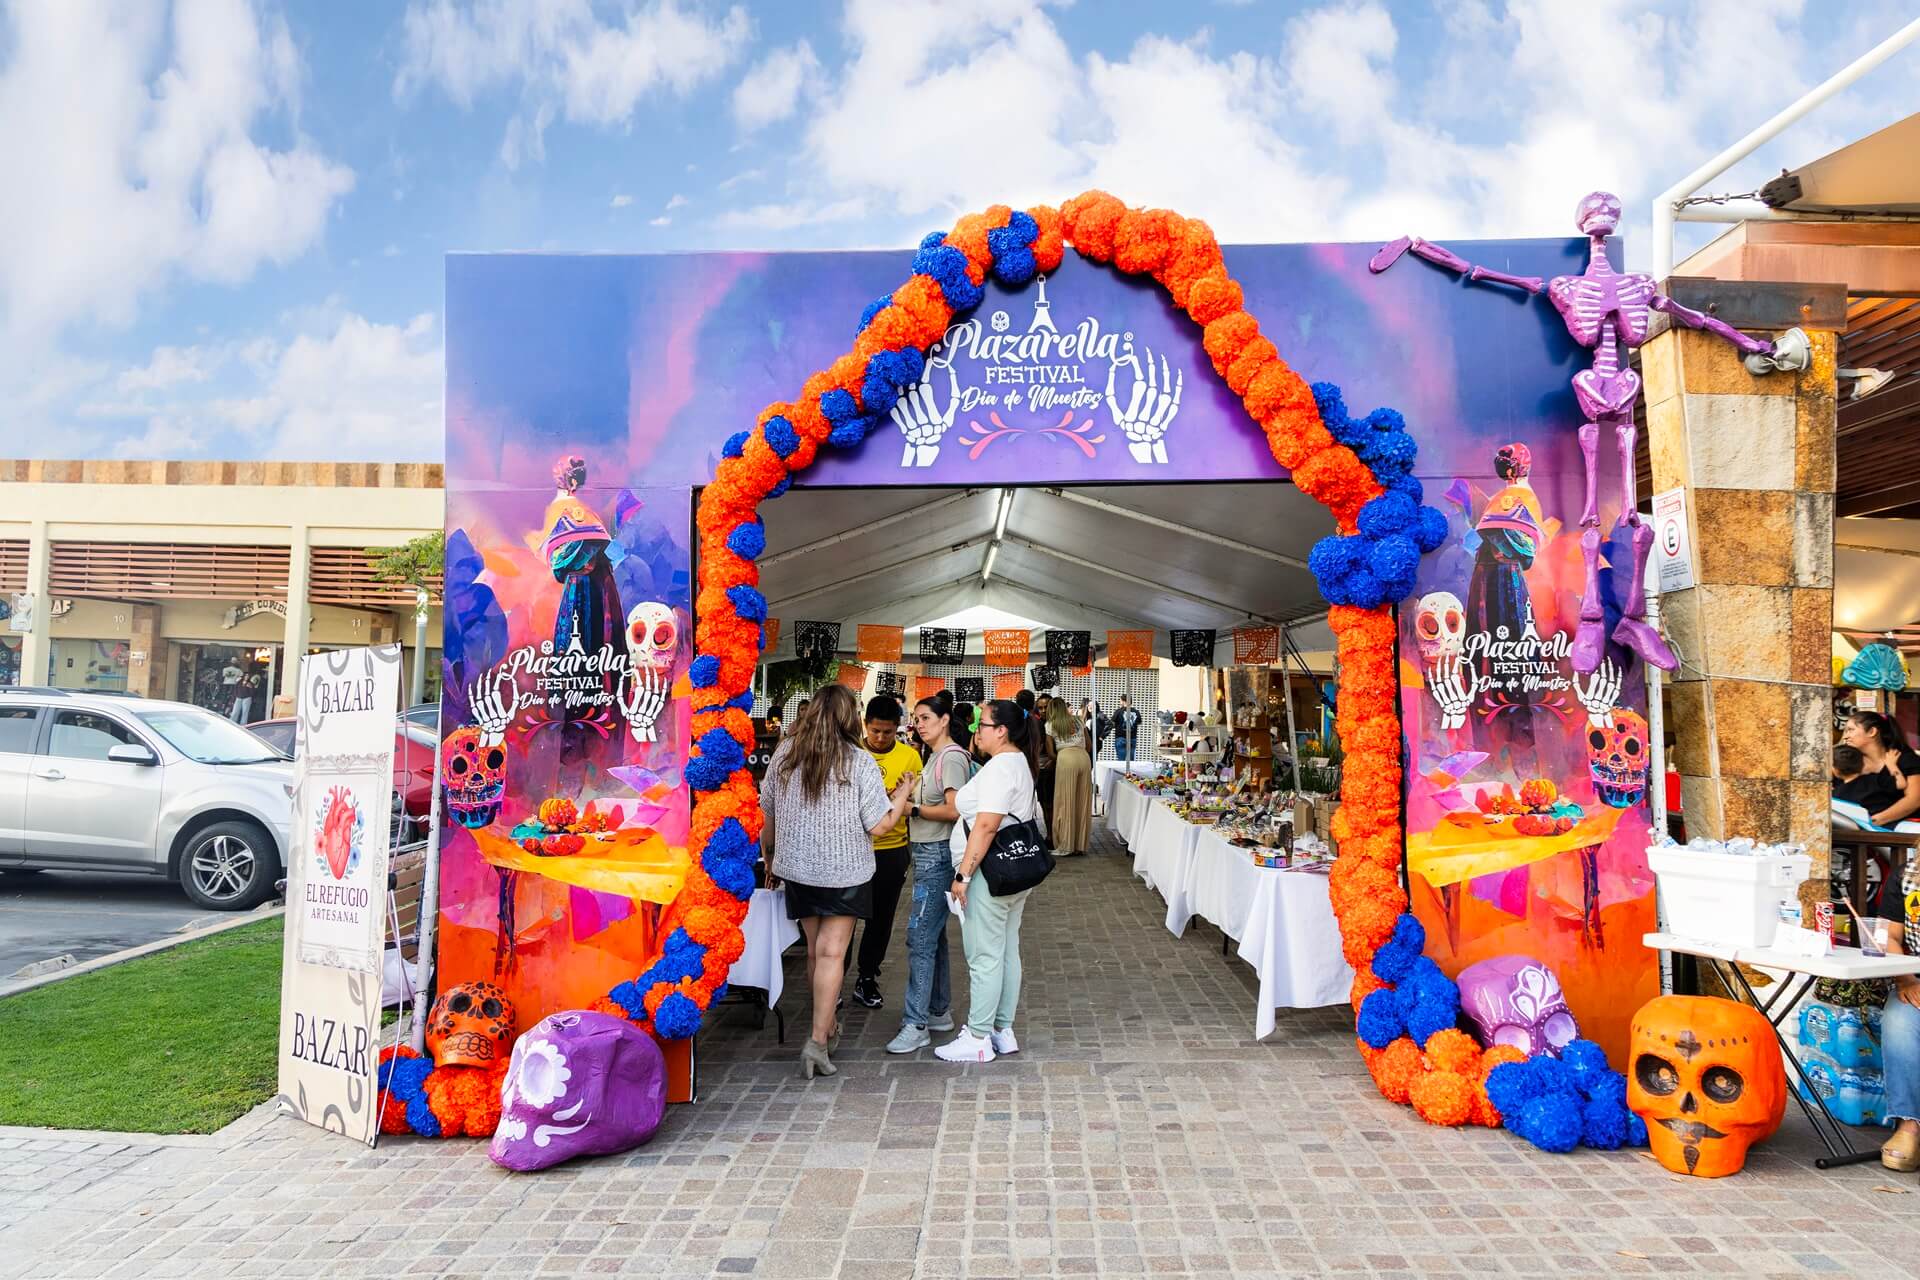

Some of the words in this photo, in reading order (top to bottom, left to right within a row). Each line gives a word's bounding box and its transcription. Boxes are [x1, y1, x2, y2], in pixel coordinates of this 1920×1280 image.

[930, 317, 1133, 367] Plazarella
[985, 365, 1085, 384] FESTIVAL
[1003, 389, 1023, 412] de
[1027, 384, 1104, 413] Muertos
[499, 643, 636, 680] Plazarella
[1493, 661, 1560, 675] FESTIVAL
[536, 676, 604, 691] FESTIVAL
[1506, 677, 1519, 692] de
[1521, 674, 1573, 693] Muertos
[319, 677, 376, 714] BAZAR
[548, 693, 562, 709] de
[564, 689, 616, 709] Muertos
[306, 883, 319, 902] EL
[319, 885, 368, 908] REFUGIO
[311, 908, 359, 924] ARTESANAL
[291, 1012, 370, 1077] BAZAR
